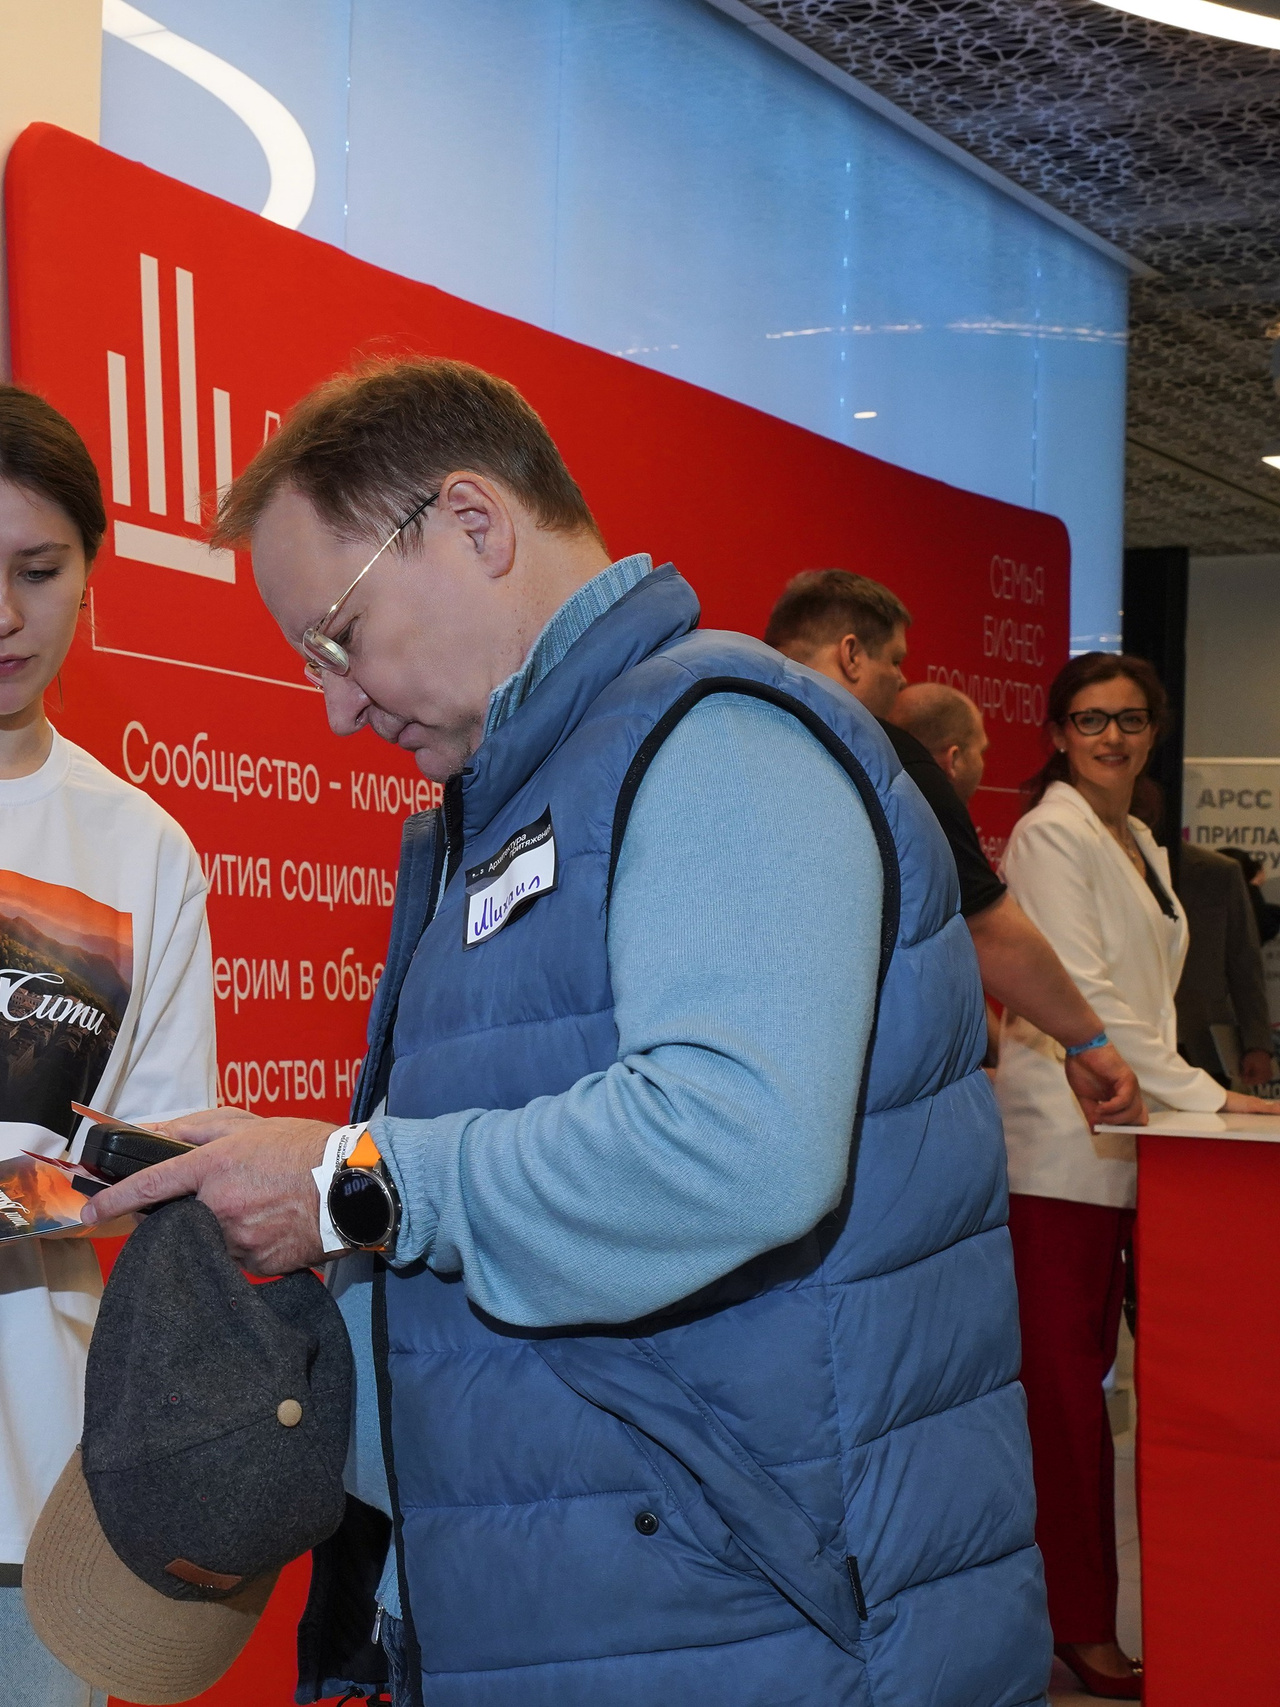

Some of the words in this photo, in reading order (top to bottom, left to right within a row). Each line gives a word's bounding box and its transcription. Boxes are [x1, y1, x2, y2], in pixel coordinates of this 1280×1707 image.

[990, 554, 1045, 606] СЕМЬЯ
[983, 614, 1045, 667] БИЗНЕС
[122, 720, 320, 805] Сообщество
[351, 770, 445, 815] ключев
[1196, 788, 1272, 810] АРСС
[1196, 826, 1280, 846] ПРИГЛА
[201, 852, 271, 899] ития
[280, 859, 398, 911] социаль
[474, 875, 541, 937] Михаил
[213, 956, 290, 1014] ерим
[300, 960, 315, 1001] в
